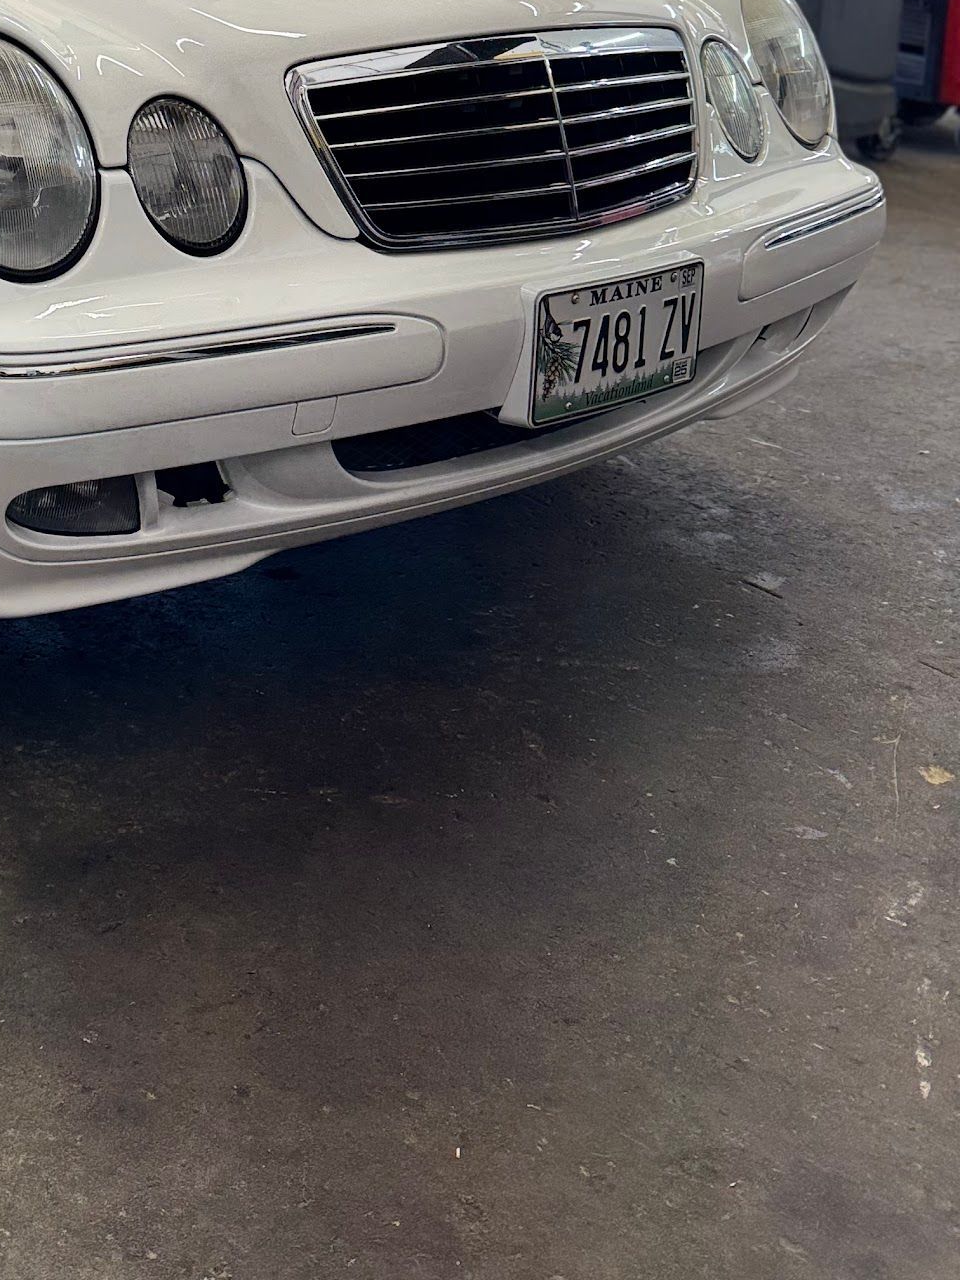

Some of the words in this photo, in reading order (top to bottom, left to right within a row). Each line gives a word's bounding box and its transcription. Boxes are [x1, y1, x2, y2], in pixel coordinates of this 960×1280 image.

[589, 275, 663, 306] MAINE
[682, 268, 696, 285] SEP
[573, 306, 647, 383] 7481
[659, 292, 696, 361] ZV
[585, 373, 655, 406] Vacationland
